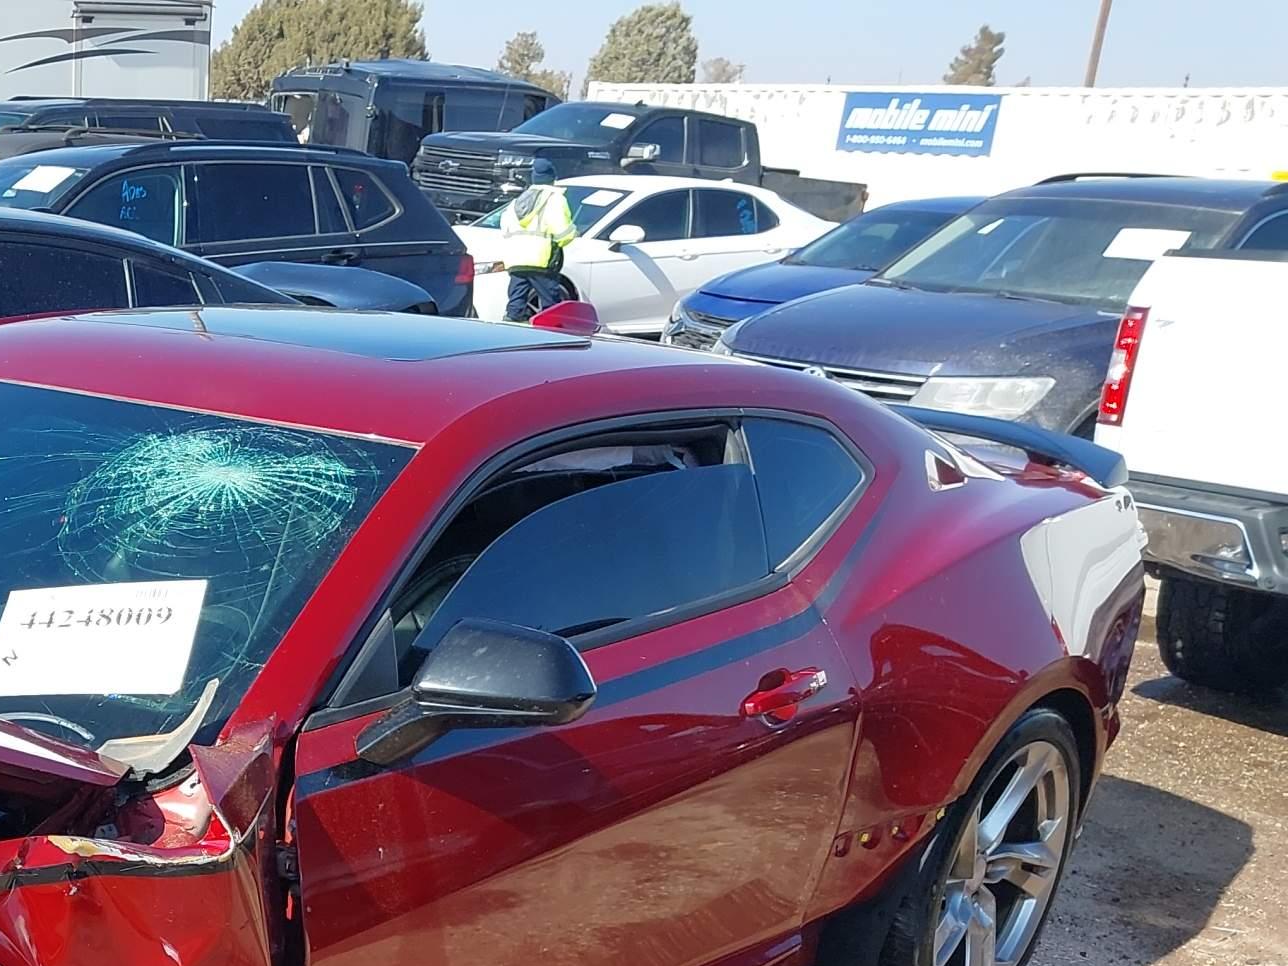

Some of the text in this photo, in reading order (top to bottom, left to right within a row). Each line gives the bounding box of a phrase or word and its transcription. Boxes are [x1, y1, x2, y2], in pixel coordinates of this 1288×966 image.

[844, 98, 997, 132] mobile mini
[20, 606, 173, 630] 44248009
